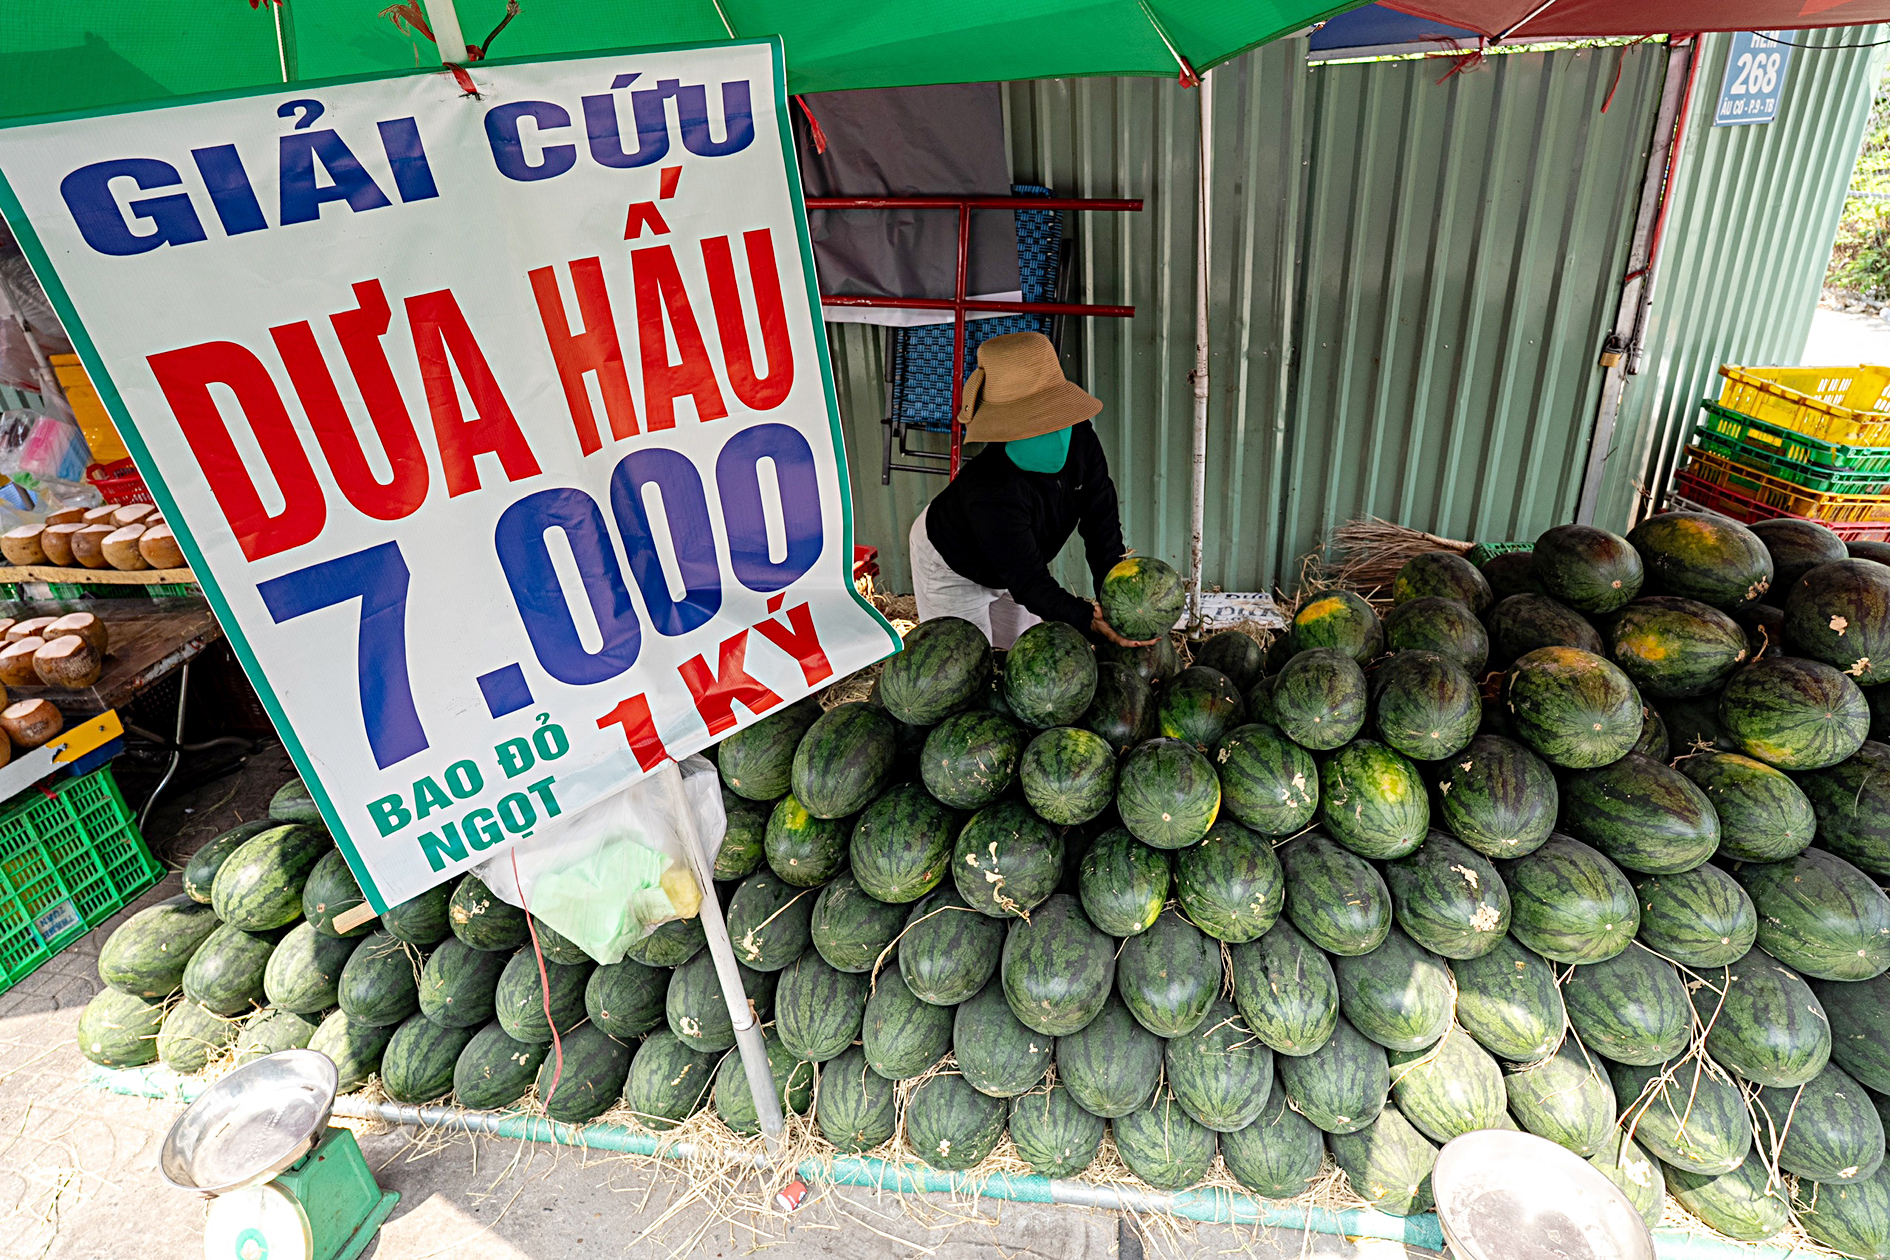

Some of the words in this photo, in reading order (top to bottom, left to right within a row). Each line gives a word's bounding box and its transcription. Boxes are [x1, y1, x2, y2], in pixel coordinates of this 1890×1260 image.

[1730, 52, 1781, 95] 268
[1764, 97, 1776, 113] TB
[60, 98, 440, 257] GIẢI
[484, 72, 756, 182] CỨU
[145, 278, 543, 563] DƯA
[527, 166, 796, 458] HẤU
[255, 422, 824, 771] 7.000
[595, 692, 680, 774] 1
[677, 591, 835, 737] KÝ
[366, 758, 485, 839] BAO
[496, 711, 571, 780] ĐỎ
[417, 775, 562, 873] NGỌT
